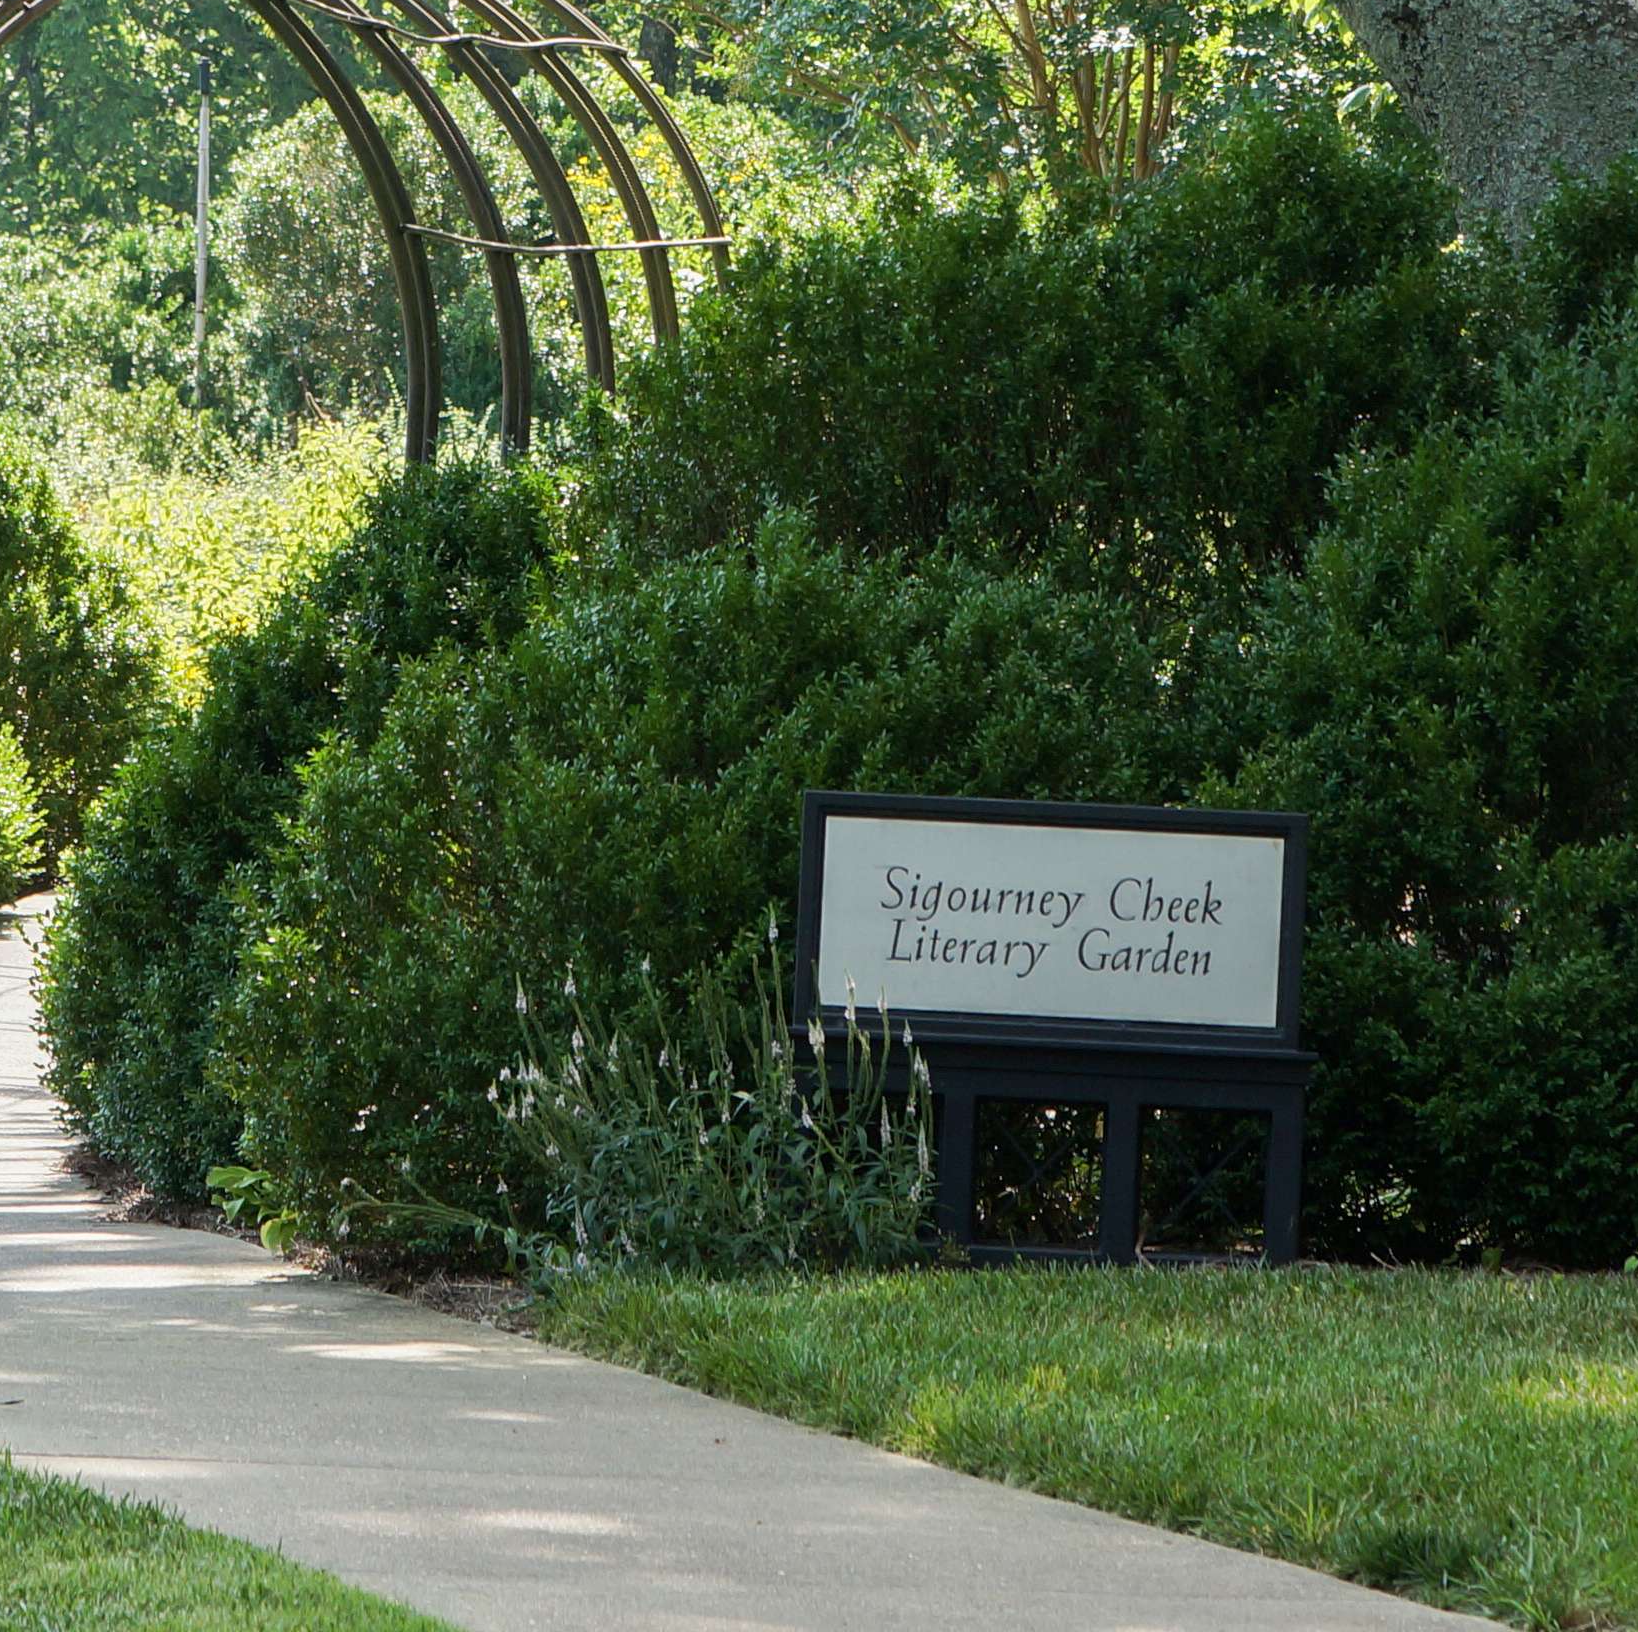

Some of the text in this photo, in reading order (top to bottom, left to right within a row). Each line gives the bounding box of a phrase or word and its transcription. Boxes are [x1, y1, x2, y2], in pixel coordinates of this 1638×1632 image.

[880, 866, 1224, 929] Sigourney Cheek
[886, 918, 1213, 979] Literary Garden
